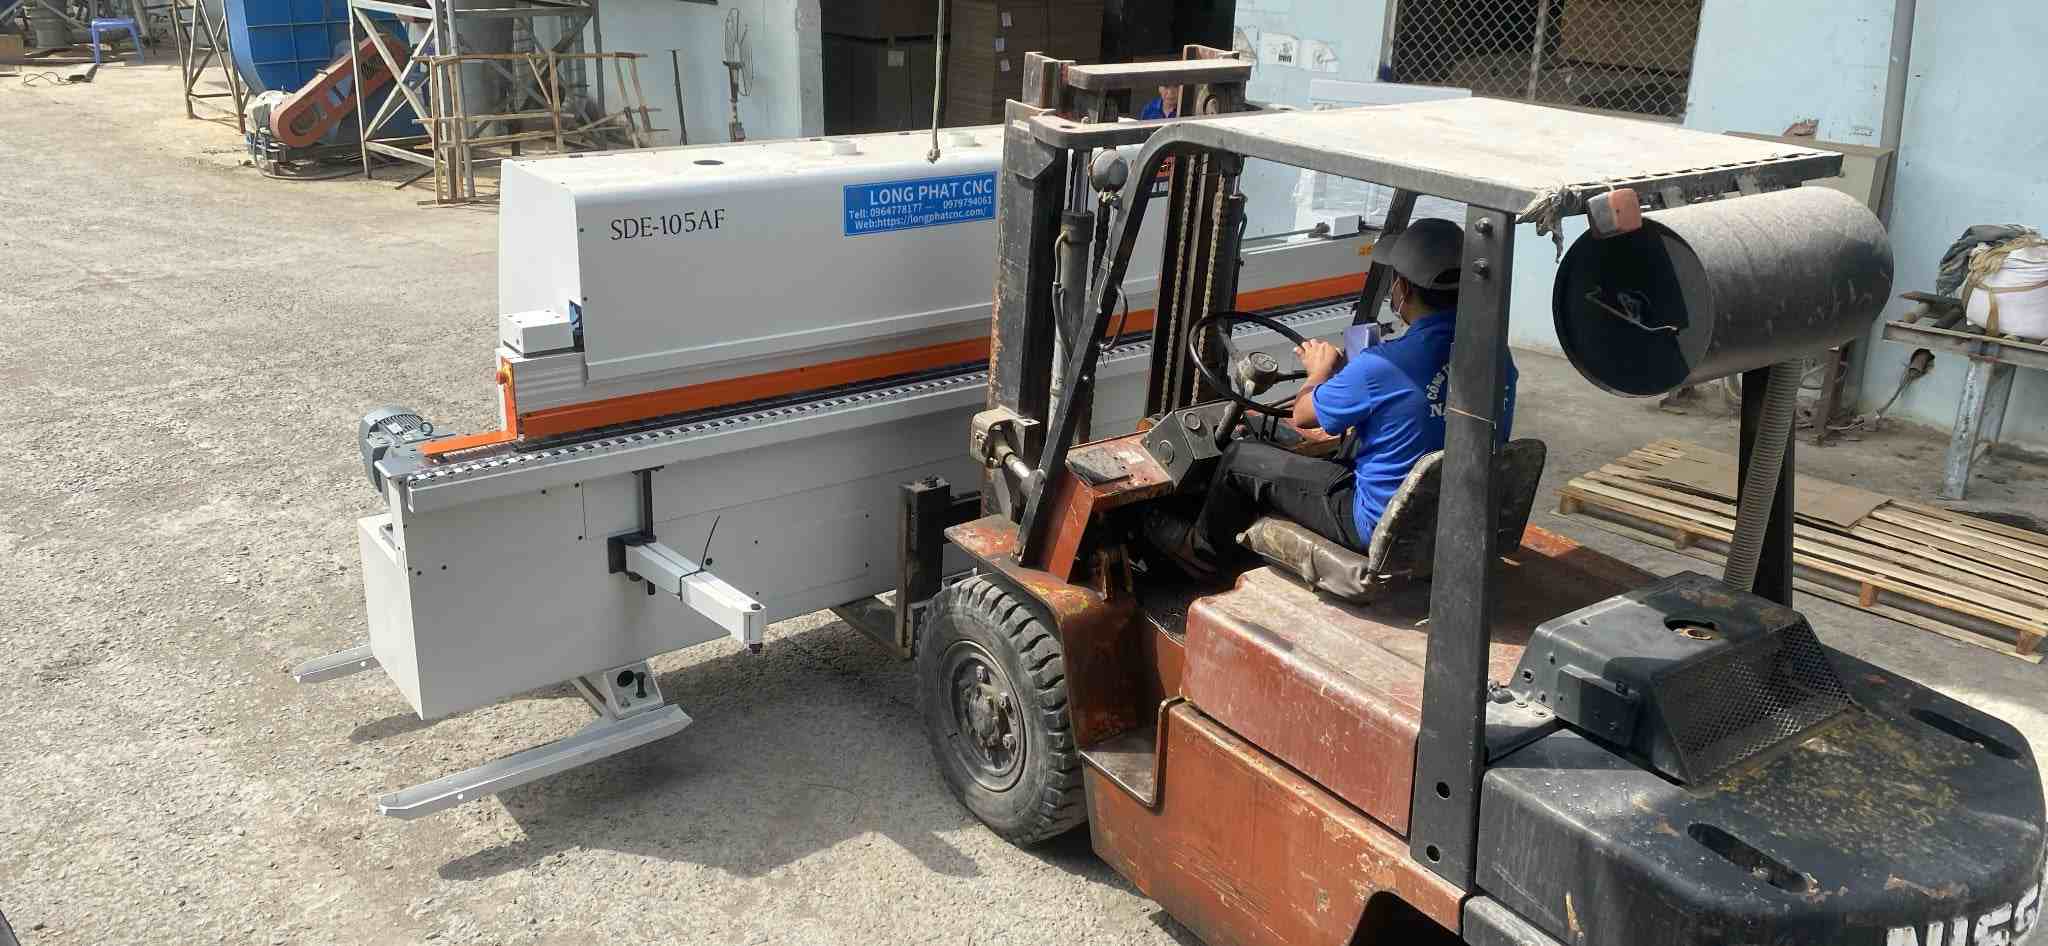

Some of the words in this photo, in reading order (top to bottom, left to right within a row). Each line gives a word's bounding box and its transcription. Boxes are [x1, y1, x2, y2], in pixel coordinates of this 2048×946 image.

[869, 186, 914, 206] LONG
[918, 182, 959, 201] PHAT
[962, 178, 993, 196] CNC
[610, 208, 725, 241] SDE-105AF
